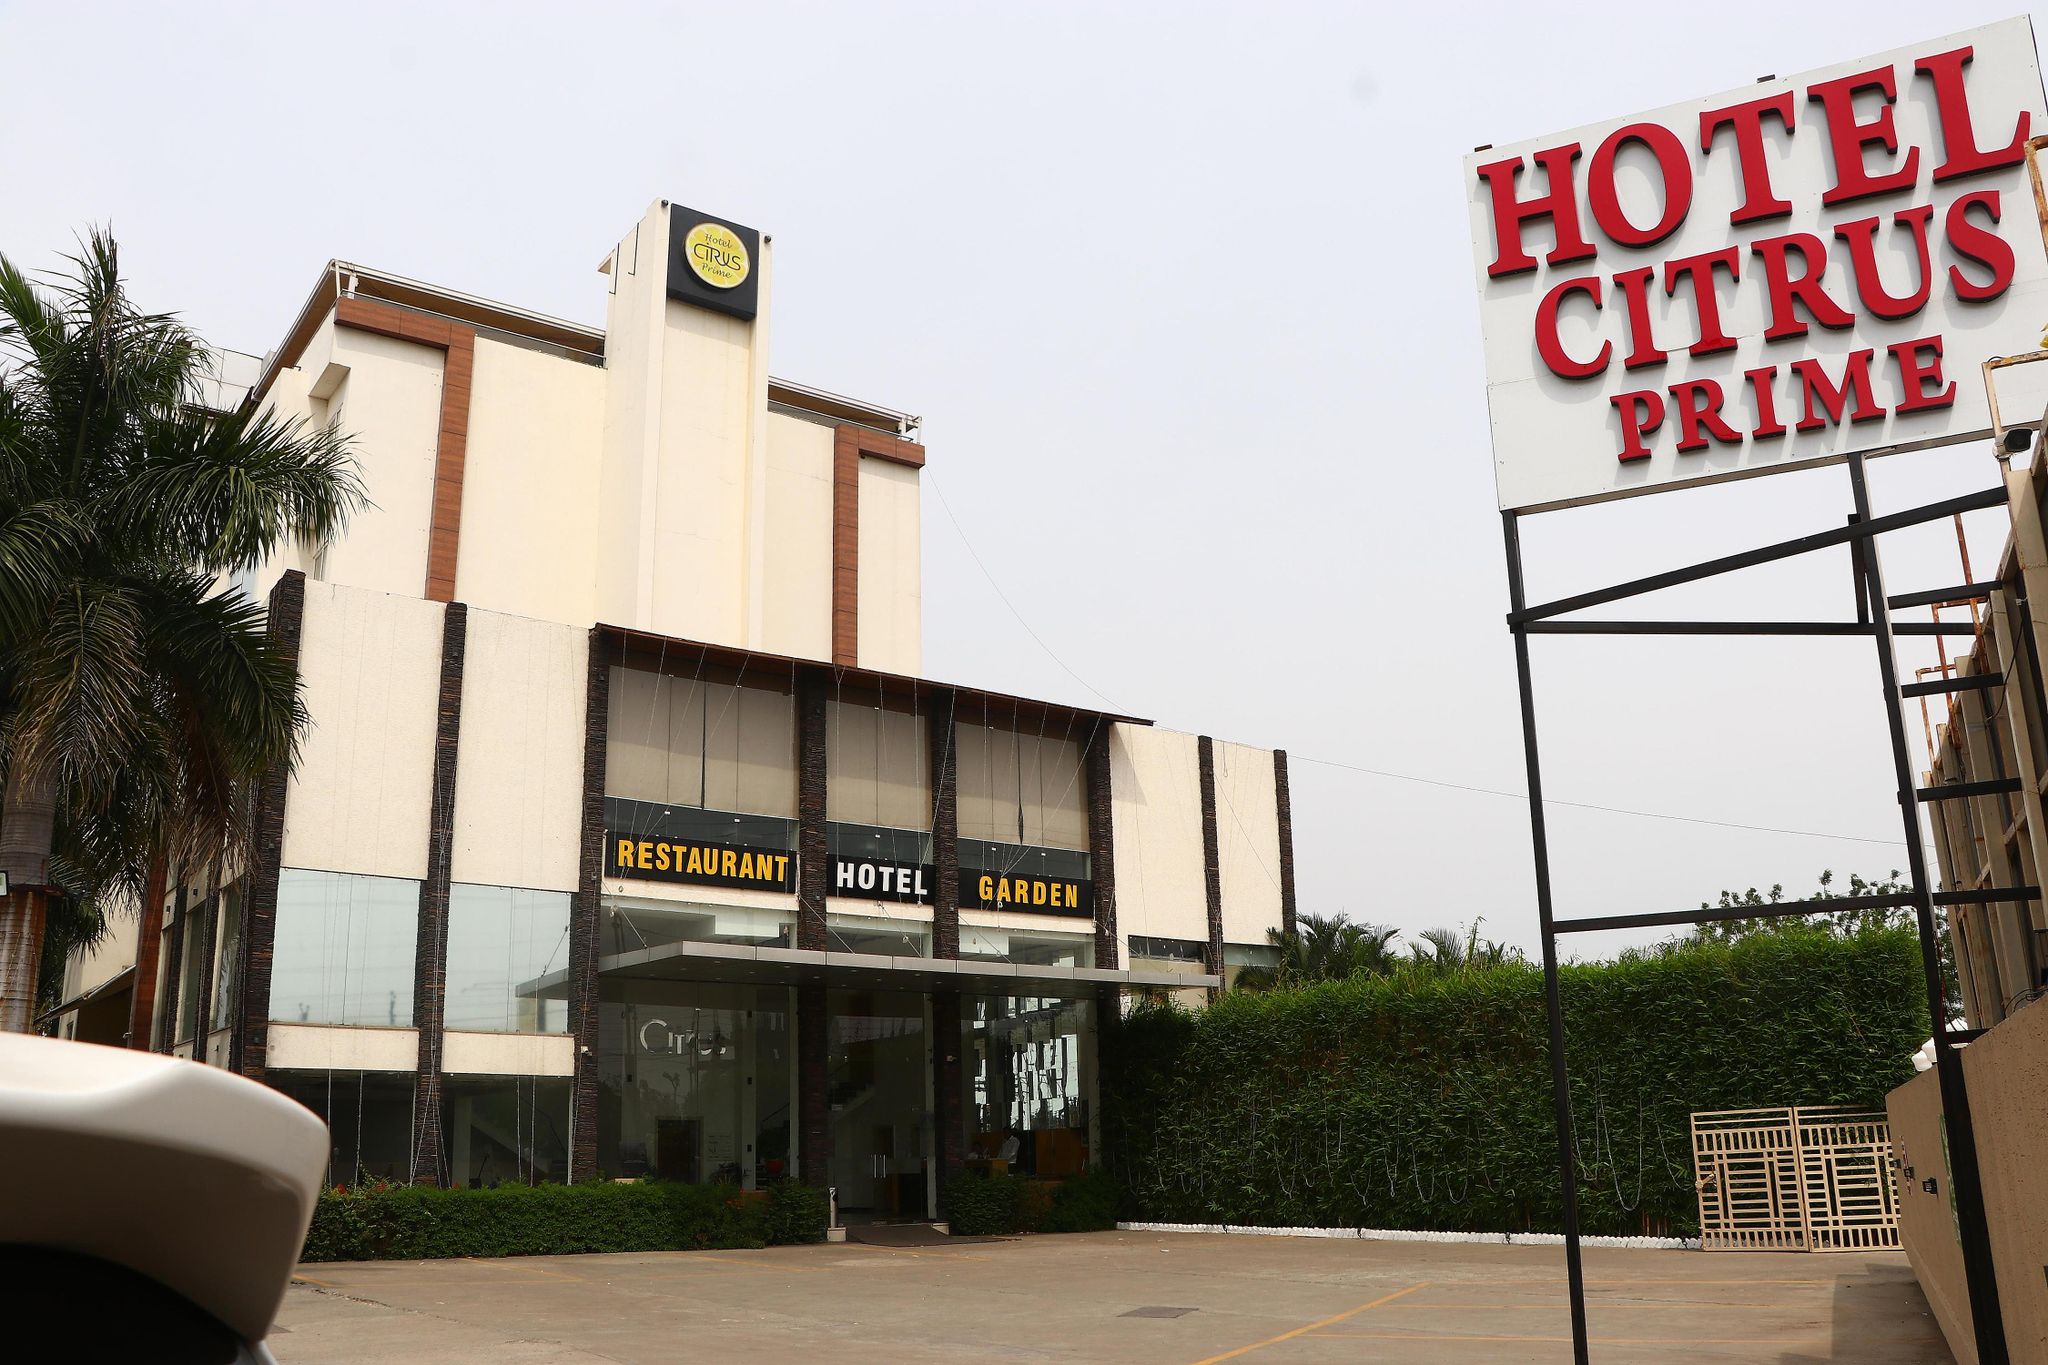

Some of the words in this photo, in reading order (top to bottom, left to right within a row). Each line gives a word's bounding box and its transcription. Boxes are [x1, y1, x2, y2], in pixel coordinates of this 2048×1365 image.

[1476, 46, 2031, 279] HOTEL
[704, 233, 733, 248] Hotel
[702, 263, 733, 279] Prime
[1534, 190, 2016, 380] CITRUS
[1609, 335, 1957, 463] PRIME
[617, 839, 789, 882] RESTAURANT
[836, 861, 928, 895] HOTEL
[978, 875, 1078, 908] GARDEN
